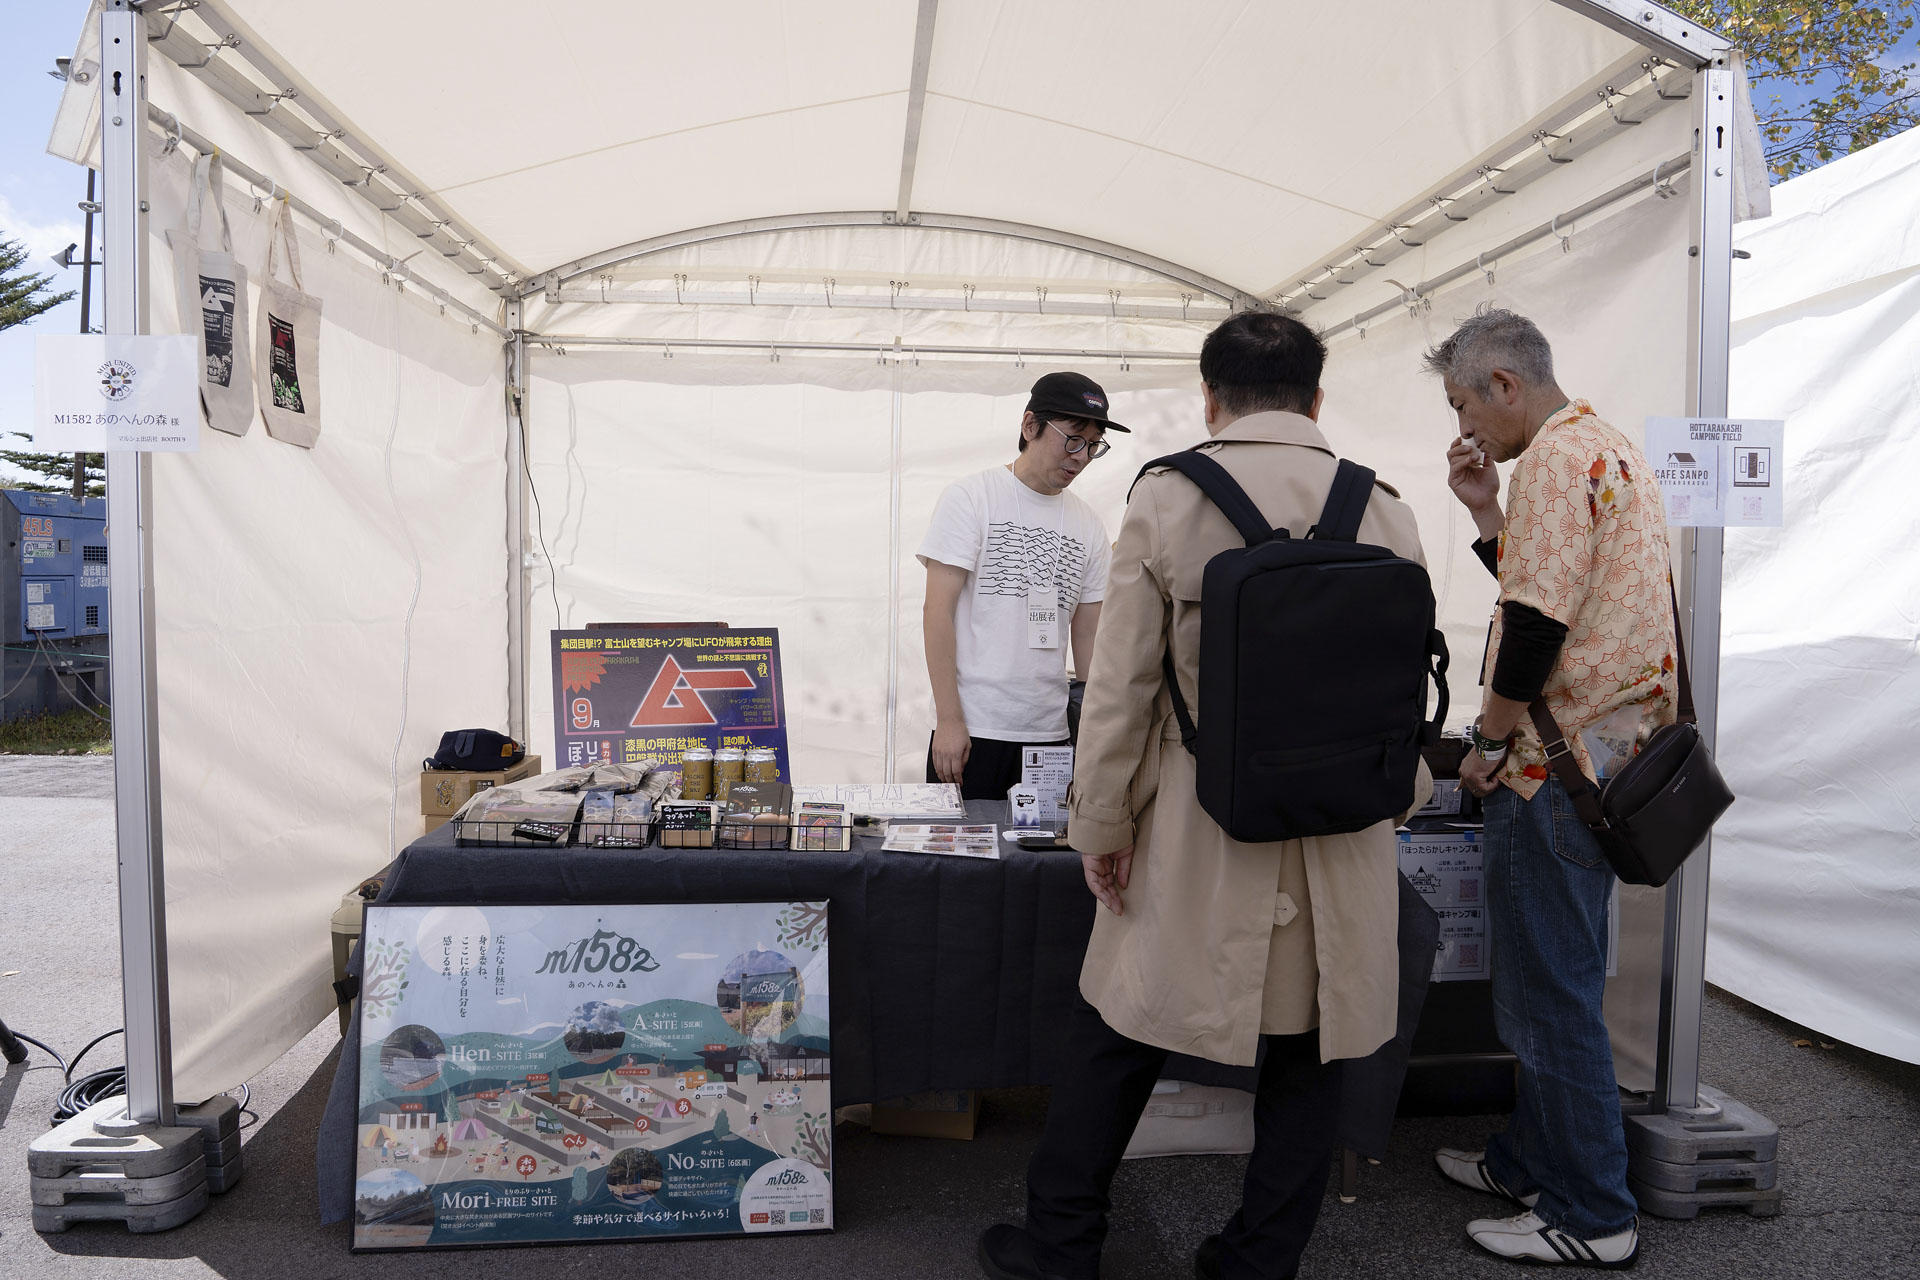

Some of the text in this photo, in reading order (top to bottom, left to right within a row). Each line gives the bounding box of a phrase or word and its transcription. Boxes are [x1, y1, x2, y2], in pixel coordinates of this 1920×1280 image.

[97, 359, 137, 376] MINI UNITED
[54, 413, 180, 426] M1582 あのへんの森 様
[1689, 423, 1743, 433] HOTTARAKASHI
[1690, 432, 1742, 441] CAMPING FIELD
[1655, 469, 1709, 480] CAFE SANPO
[23, 517, 53, 537] 45LS
[1029, 612, 1056, 622] 出展者
[605, 637, 773, 649] 富士山を望むキャンプ場にUFOが飛来する理由
[625, 737, 708, 752] 漆黒の甲府盆地に
[665, 812, 695, 820] マグネット
[1401, 844, 1482, 854] 「ほったらかしキャンプ場」
[478, 934, 488, 980] 身を委ね、
[535, 928, 661, 974] m1582
[441, 935, 453, 981] 感じる森。
[495, 935, 506, 996] 広大な自然に
[459, 936, 469, 1018] ここに在る自分を
[568, 978, 627, 989] あのへんの森
[678, 1101, 689, 1111] あ
[636, 1119, 648, 1129] の
[564, 1135, 585, 1145] へん
[765, 1168, 809, 1186] m1582
[531, 1195, 558, 1207] SITE
